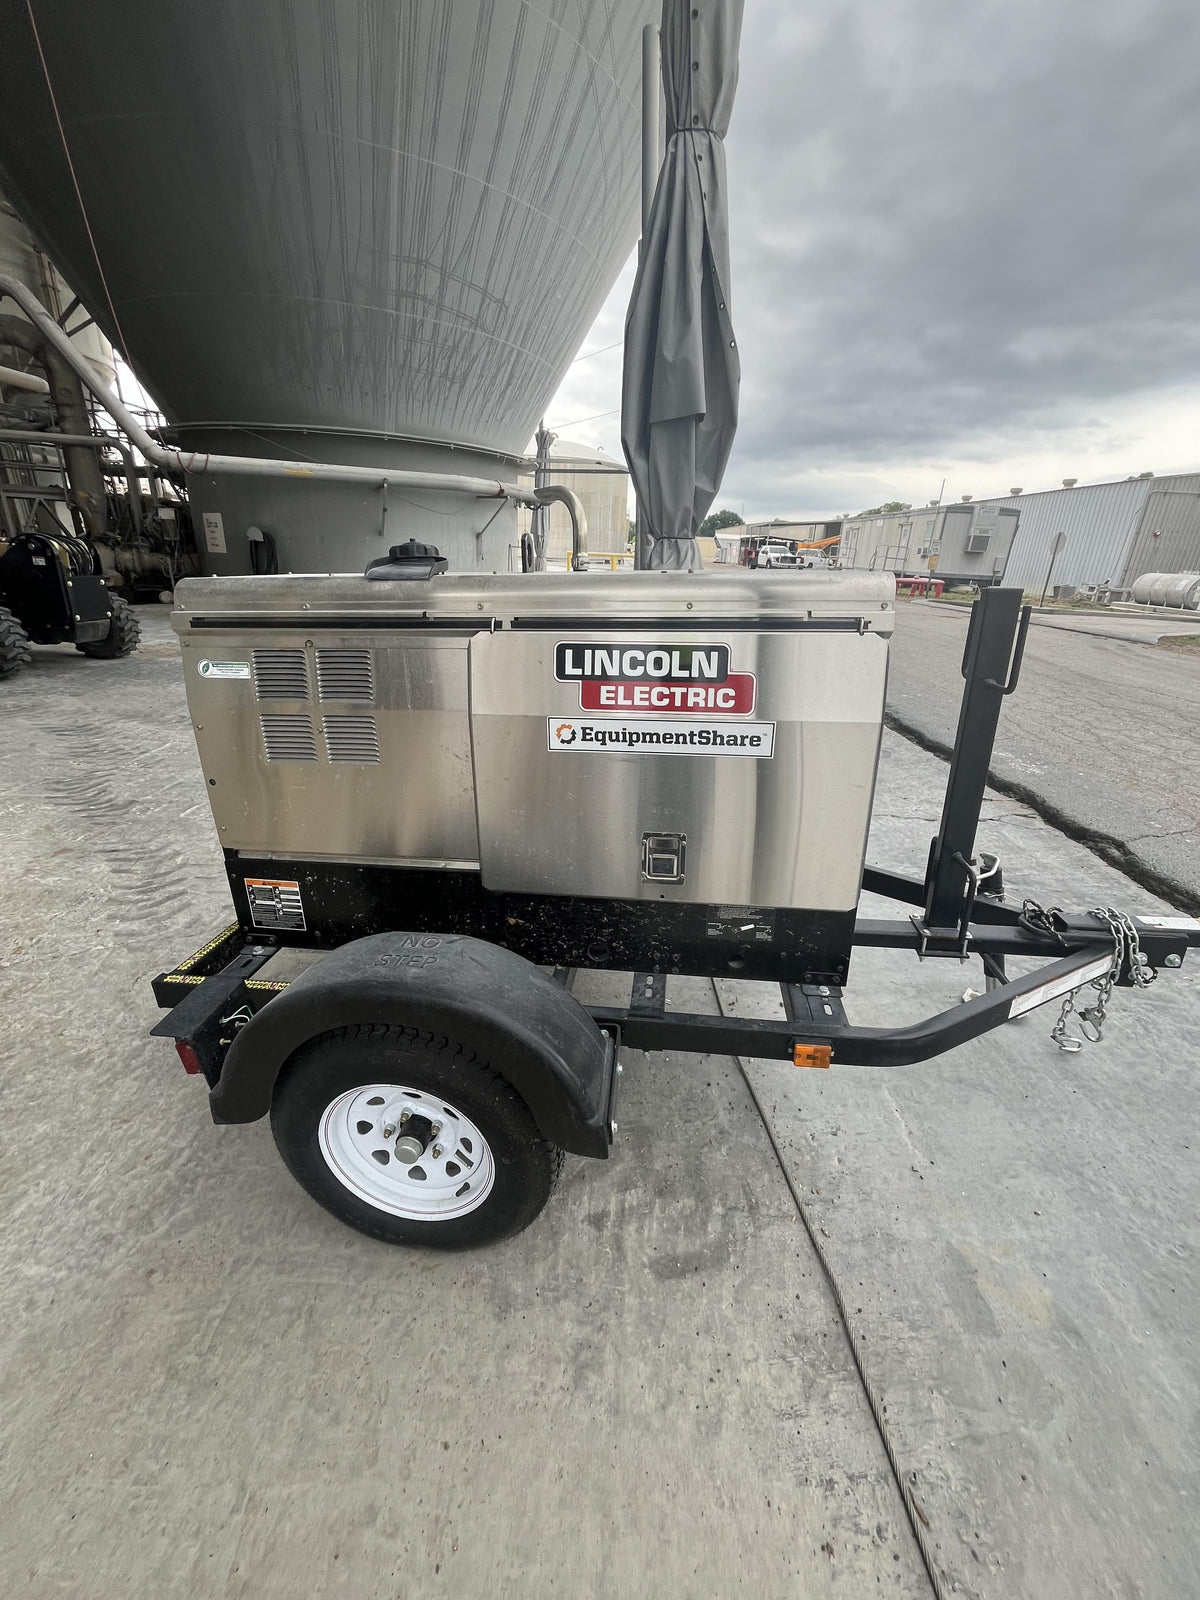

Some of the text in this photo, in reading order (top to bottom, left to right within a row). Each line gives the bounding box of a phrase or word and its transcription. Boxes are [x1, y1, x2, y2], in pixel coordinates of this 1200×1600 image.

[564, 648, 719, 678] LINCOLN
[600, 685, 736, 708] ELECTRIC
[401, 935, 441, 949] NO
[375, 954, 439, 969] STEP
